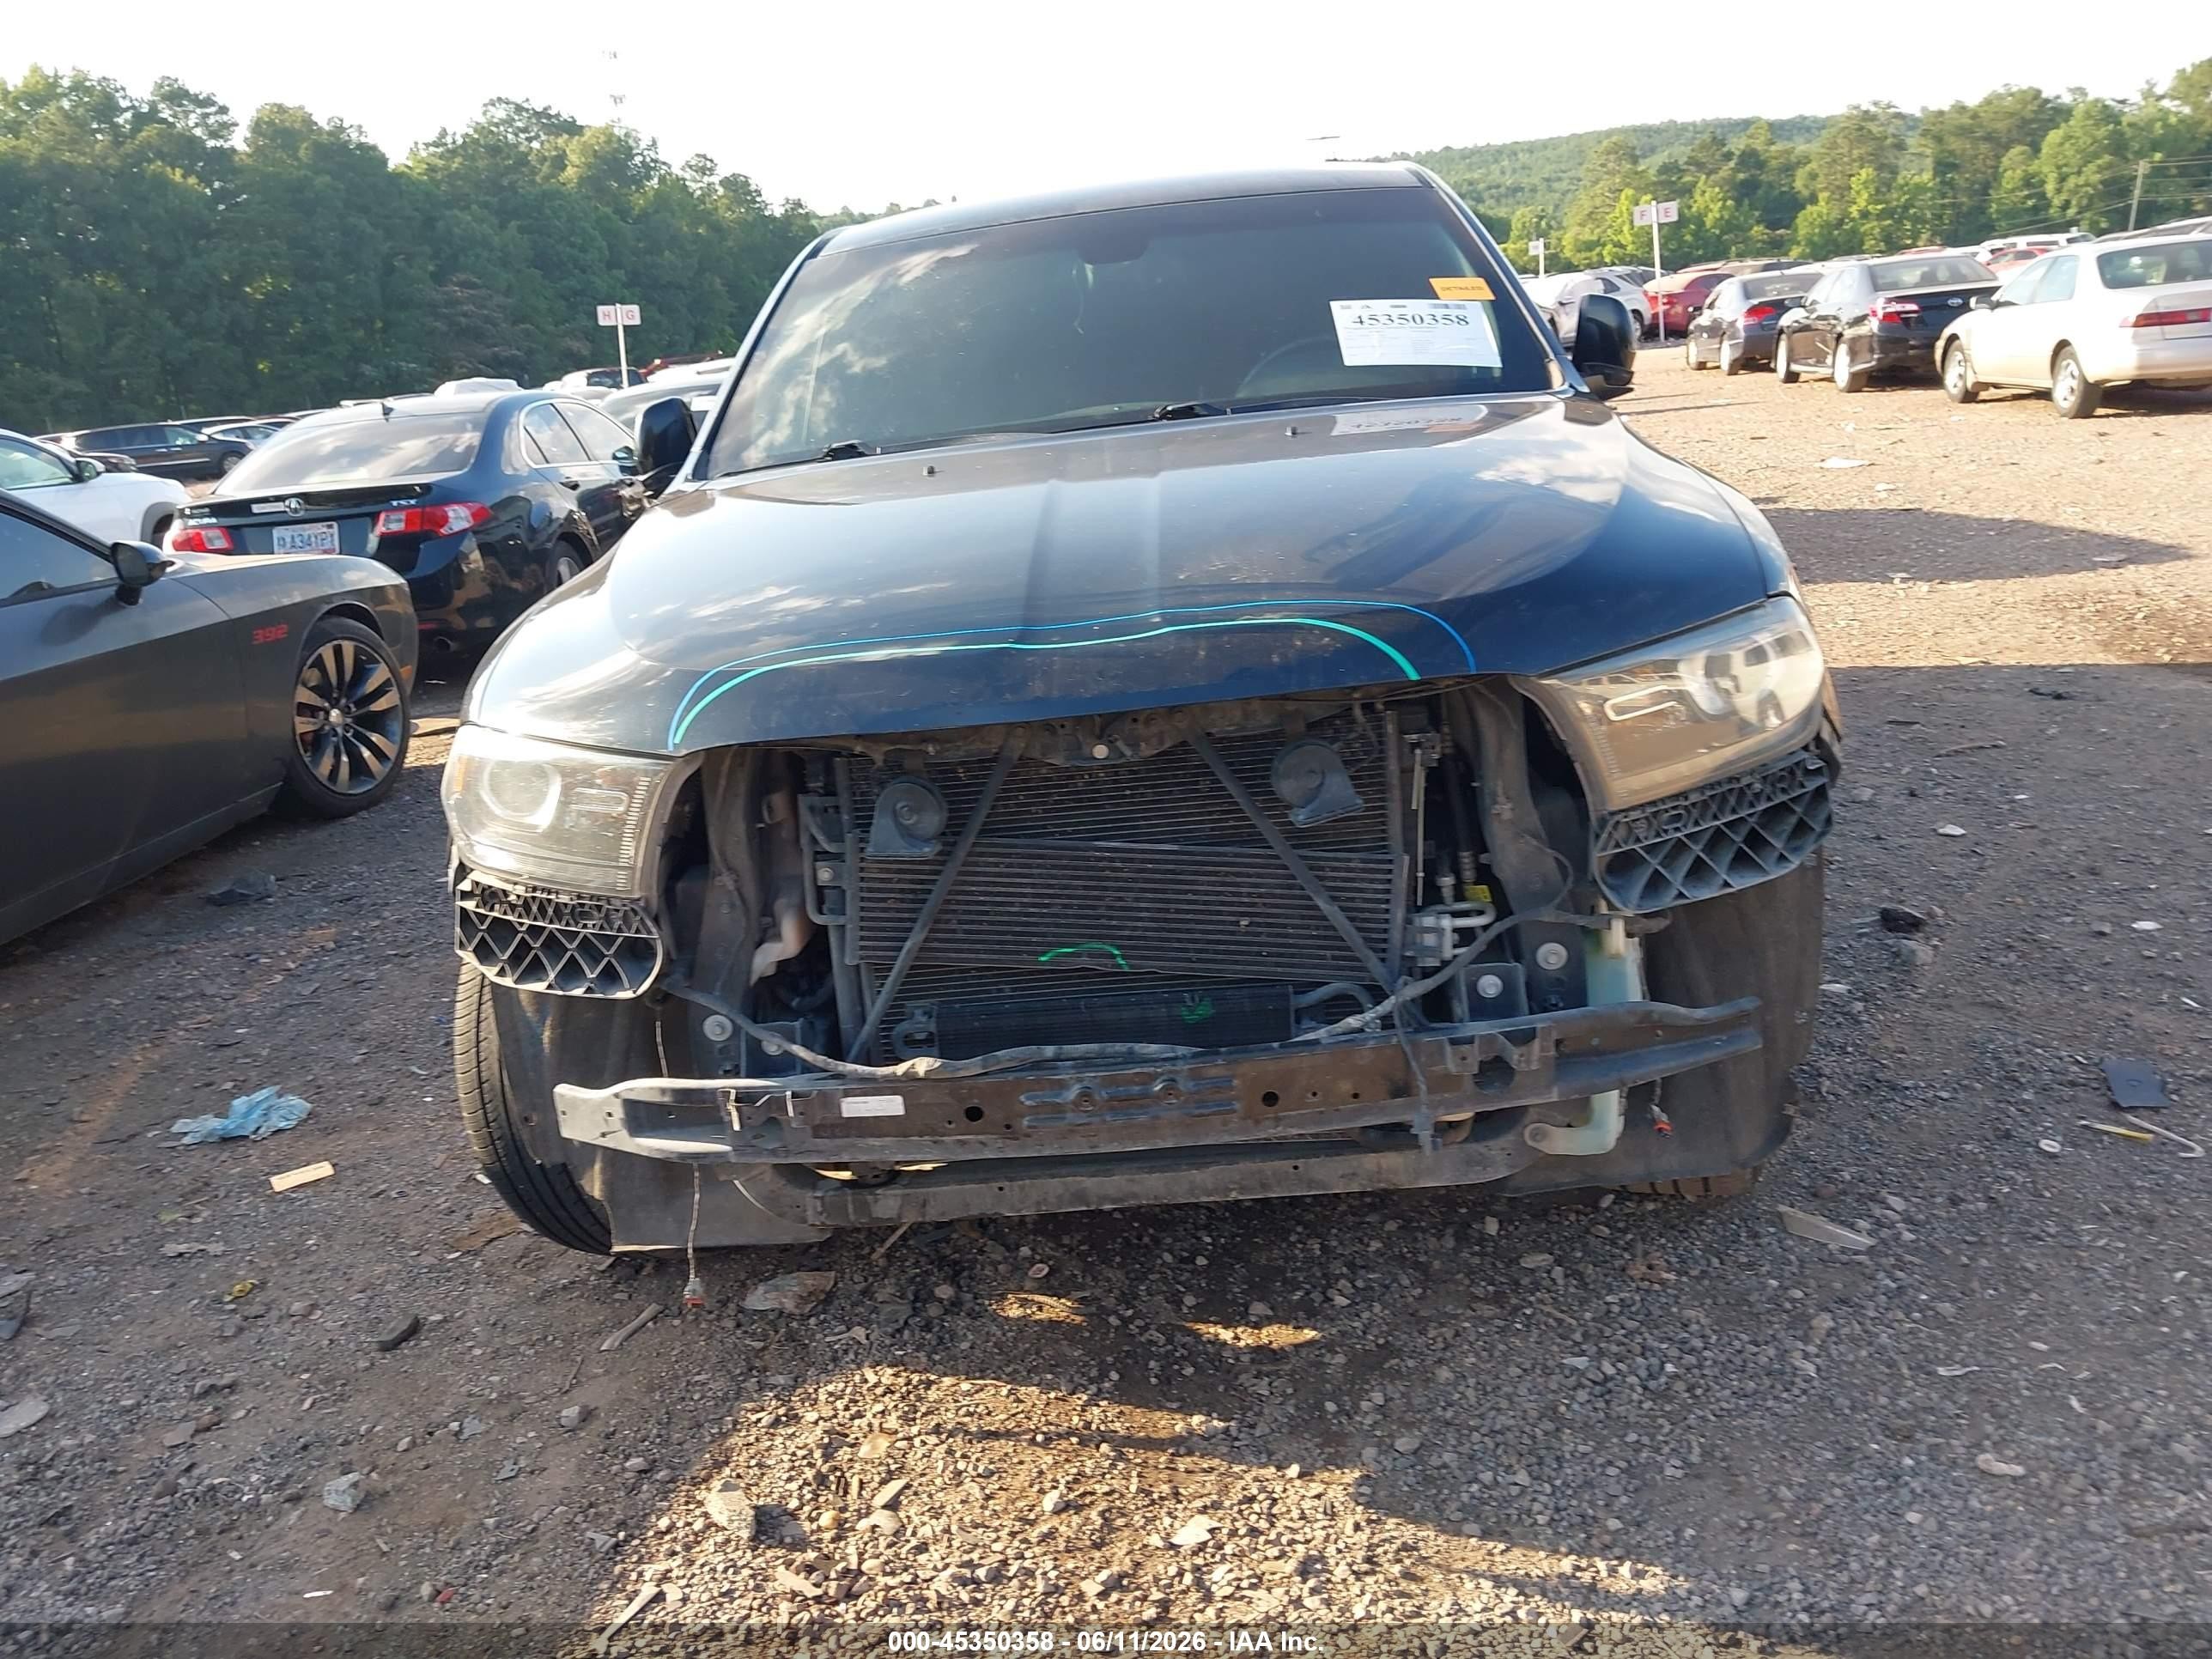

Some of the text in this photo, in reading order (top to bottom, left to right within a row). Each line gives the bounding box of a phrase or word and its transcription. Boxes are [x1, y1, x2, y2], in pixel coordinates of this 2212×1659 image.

[1663, 207, 1671, 218] E
[602, 309, 611, 321] H
[625, 309, 635, 320] G
[1351, 313, 1470, 326] 45350358
[251, 624, 289, 644] 392
